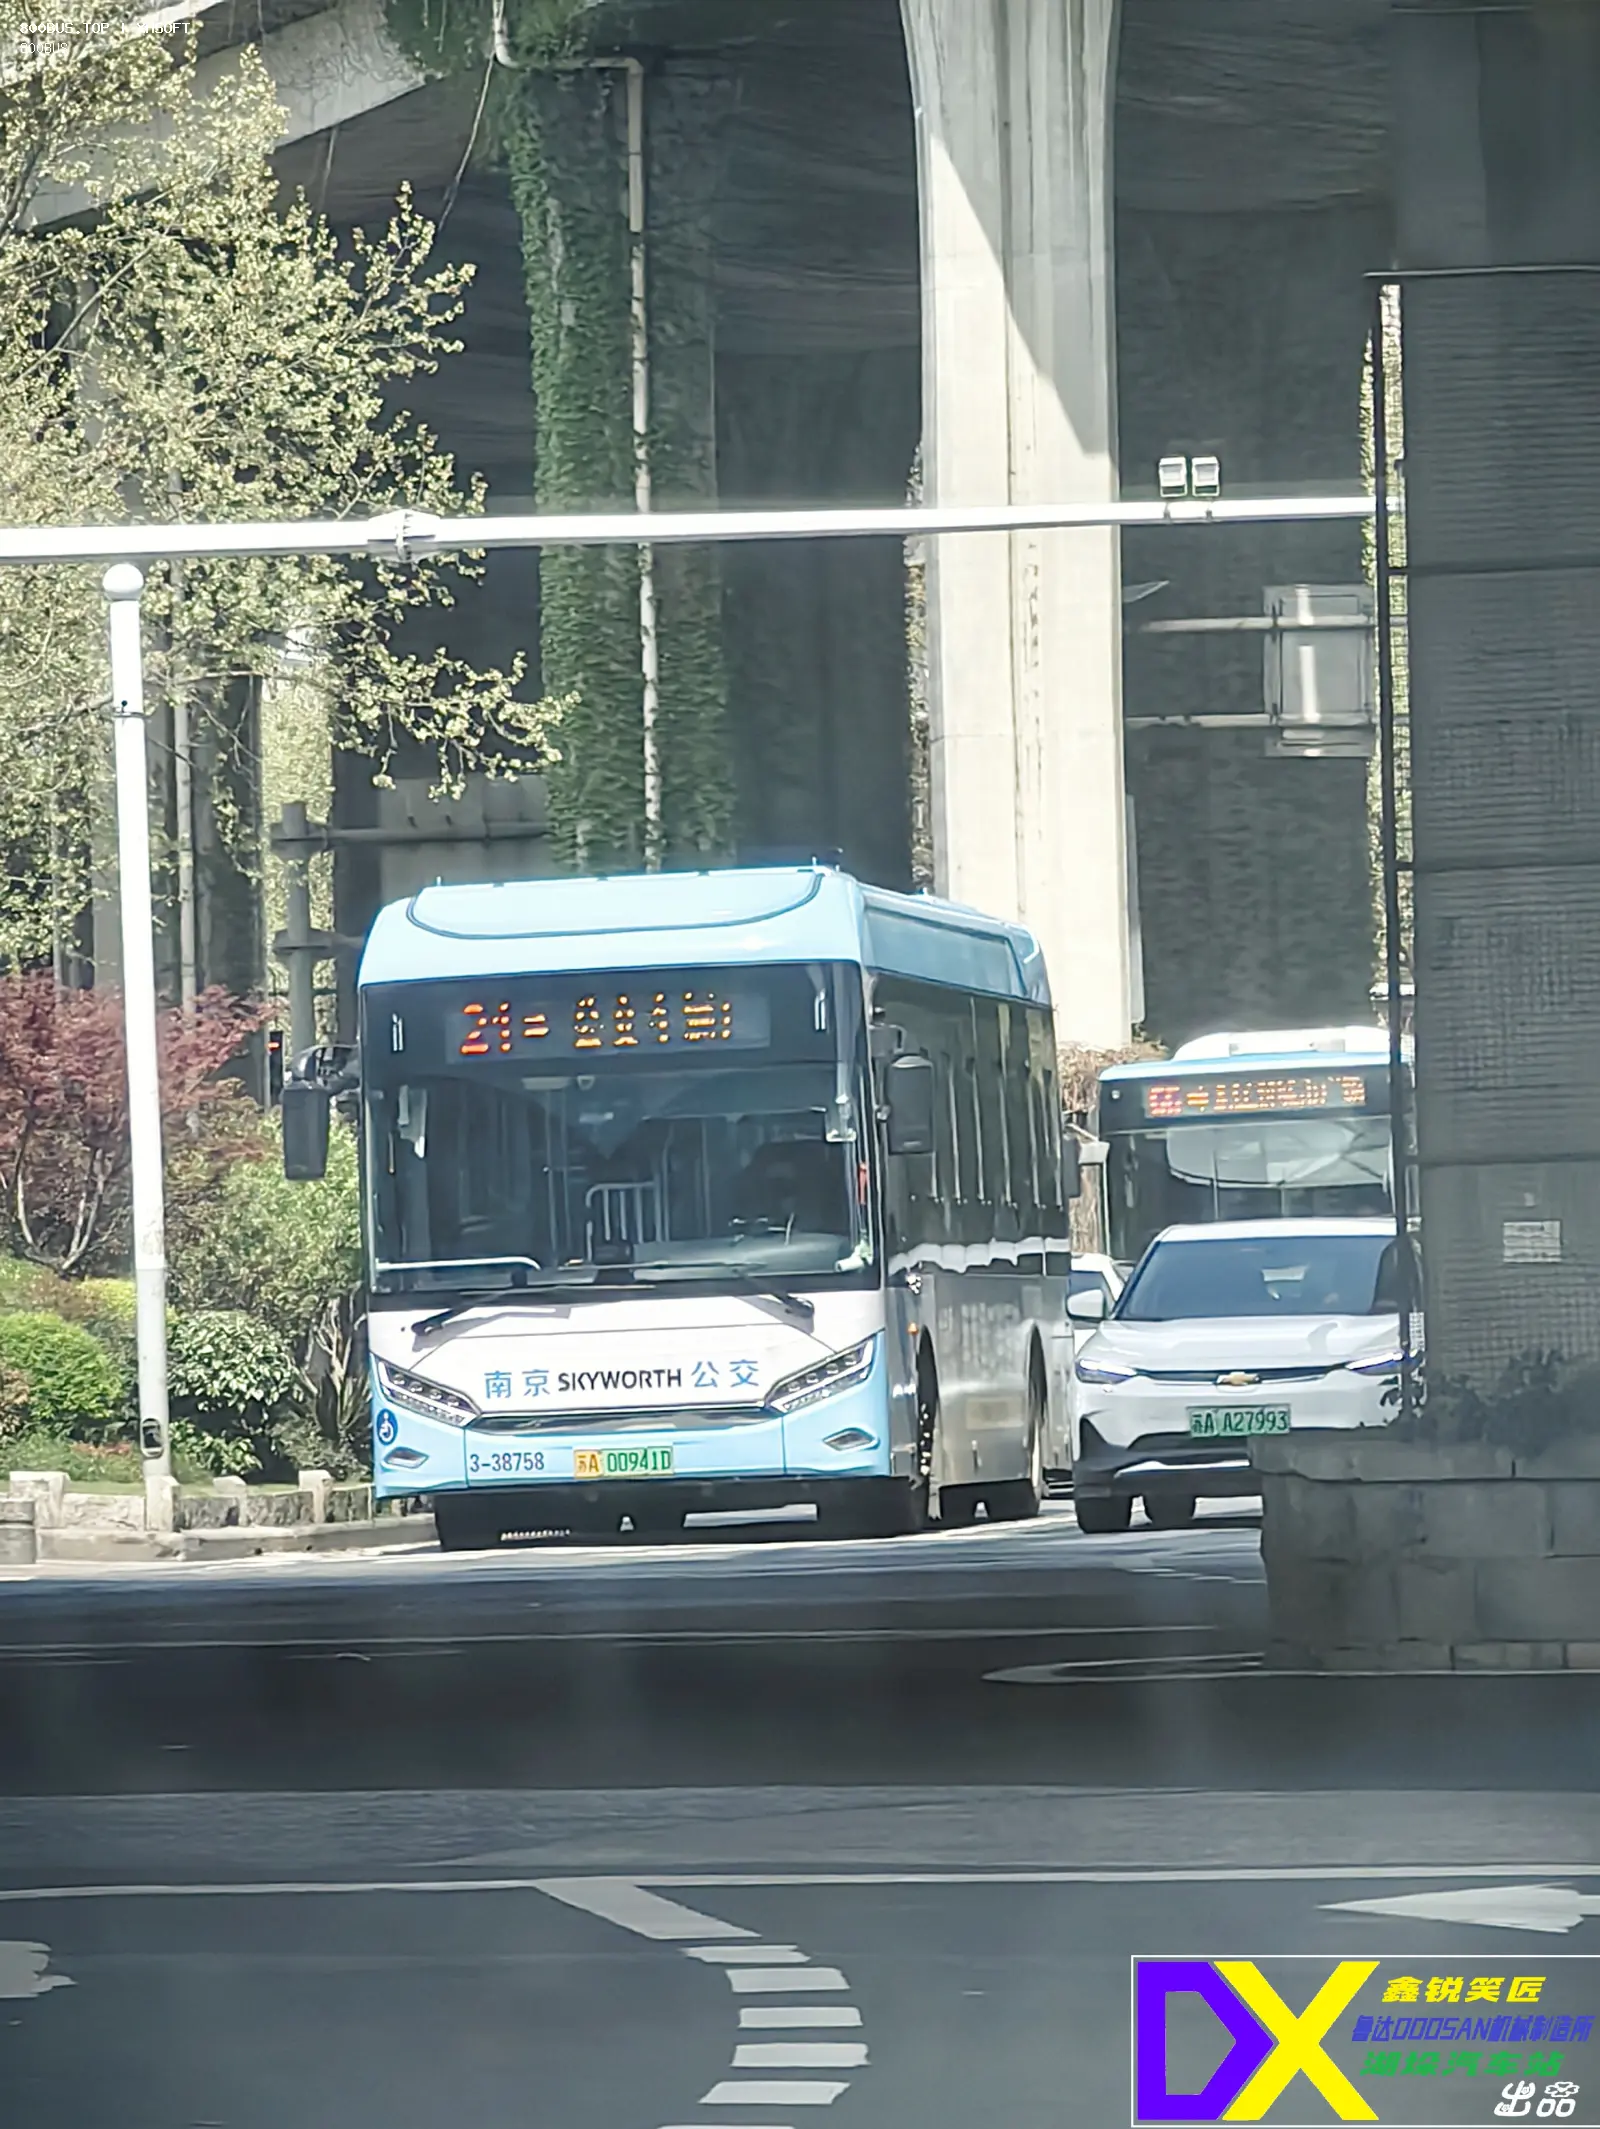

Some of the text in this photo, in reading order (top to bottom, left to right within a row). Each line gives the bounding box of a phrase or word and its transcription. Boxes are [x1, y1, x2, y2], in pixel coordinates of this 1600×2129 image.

[484, 1359, 760, 1399] 南京 SKYWORTH 公交
[469, 1451, 545, 1474] 3-38758
